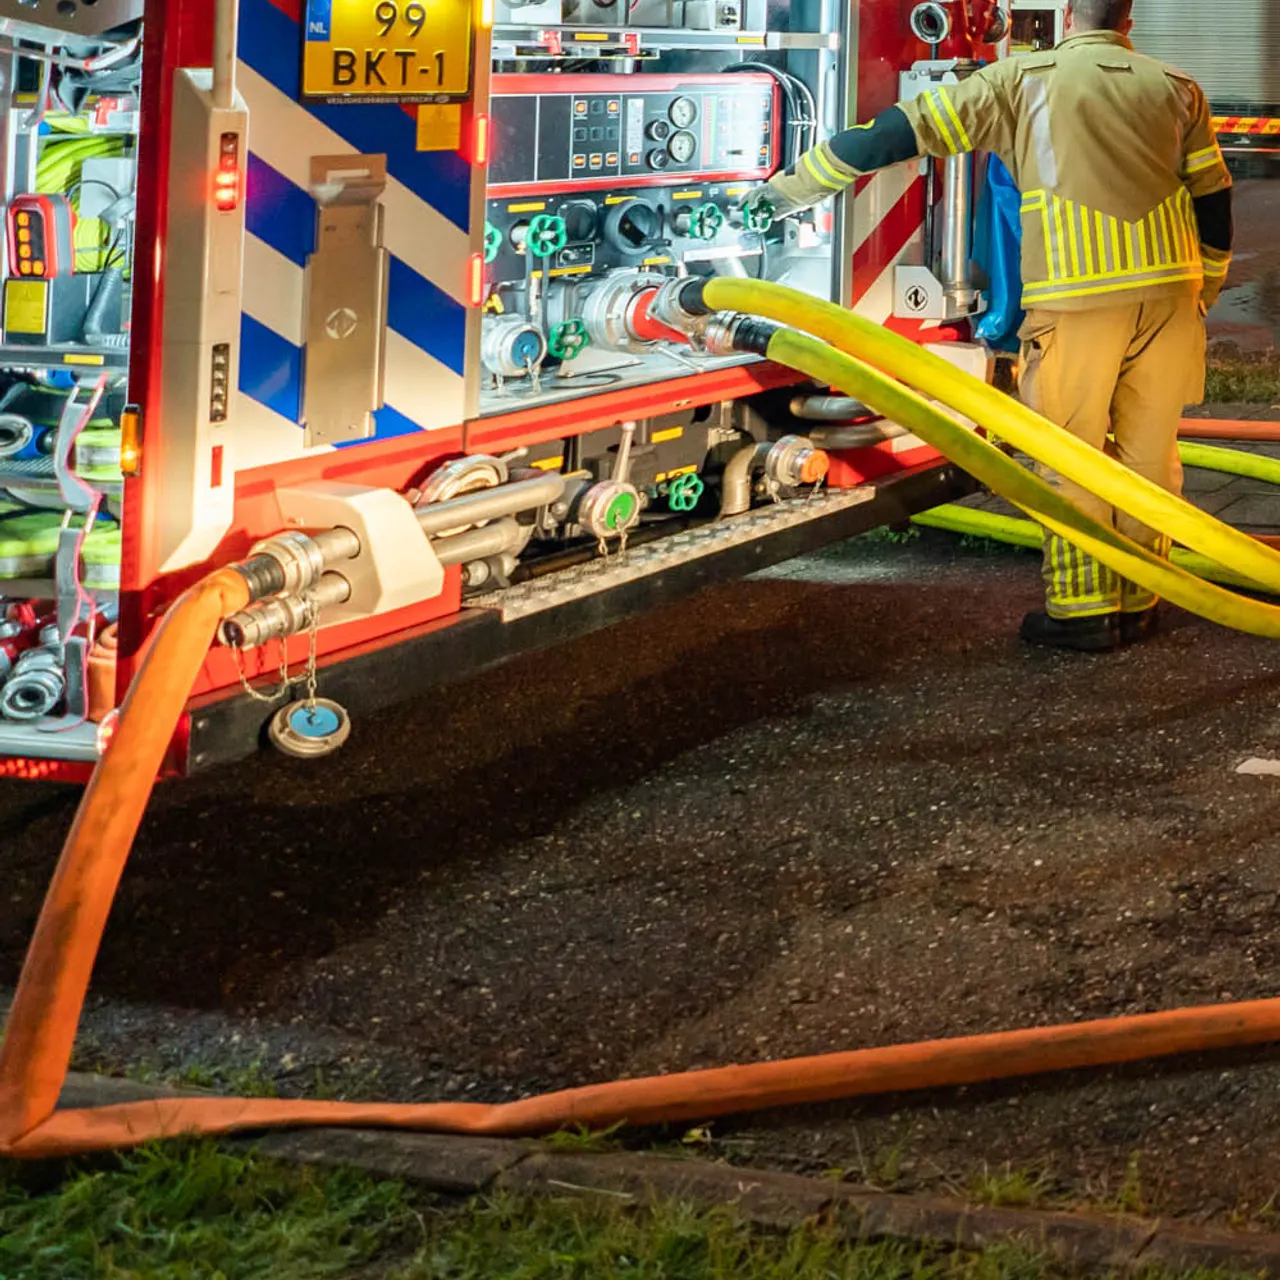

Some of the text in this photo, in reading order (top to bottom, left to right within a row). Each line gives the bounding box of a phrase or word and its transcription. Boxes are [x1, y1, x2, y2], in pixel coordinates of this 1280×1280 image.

[309, 21, 327, 34] NL
[376, 1, 426, 37] 99
[332, 49, 445, 87] BKT-1
